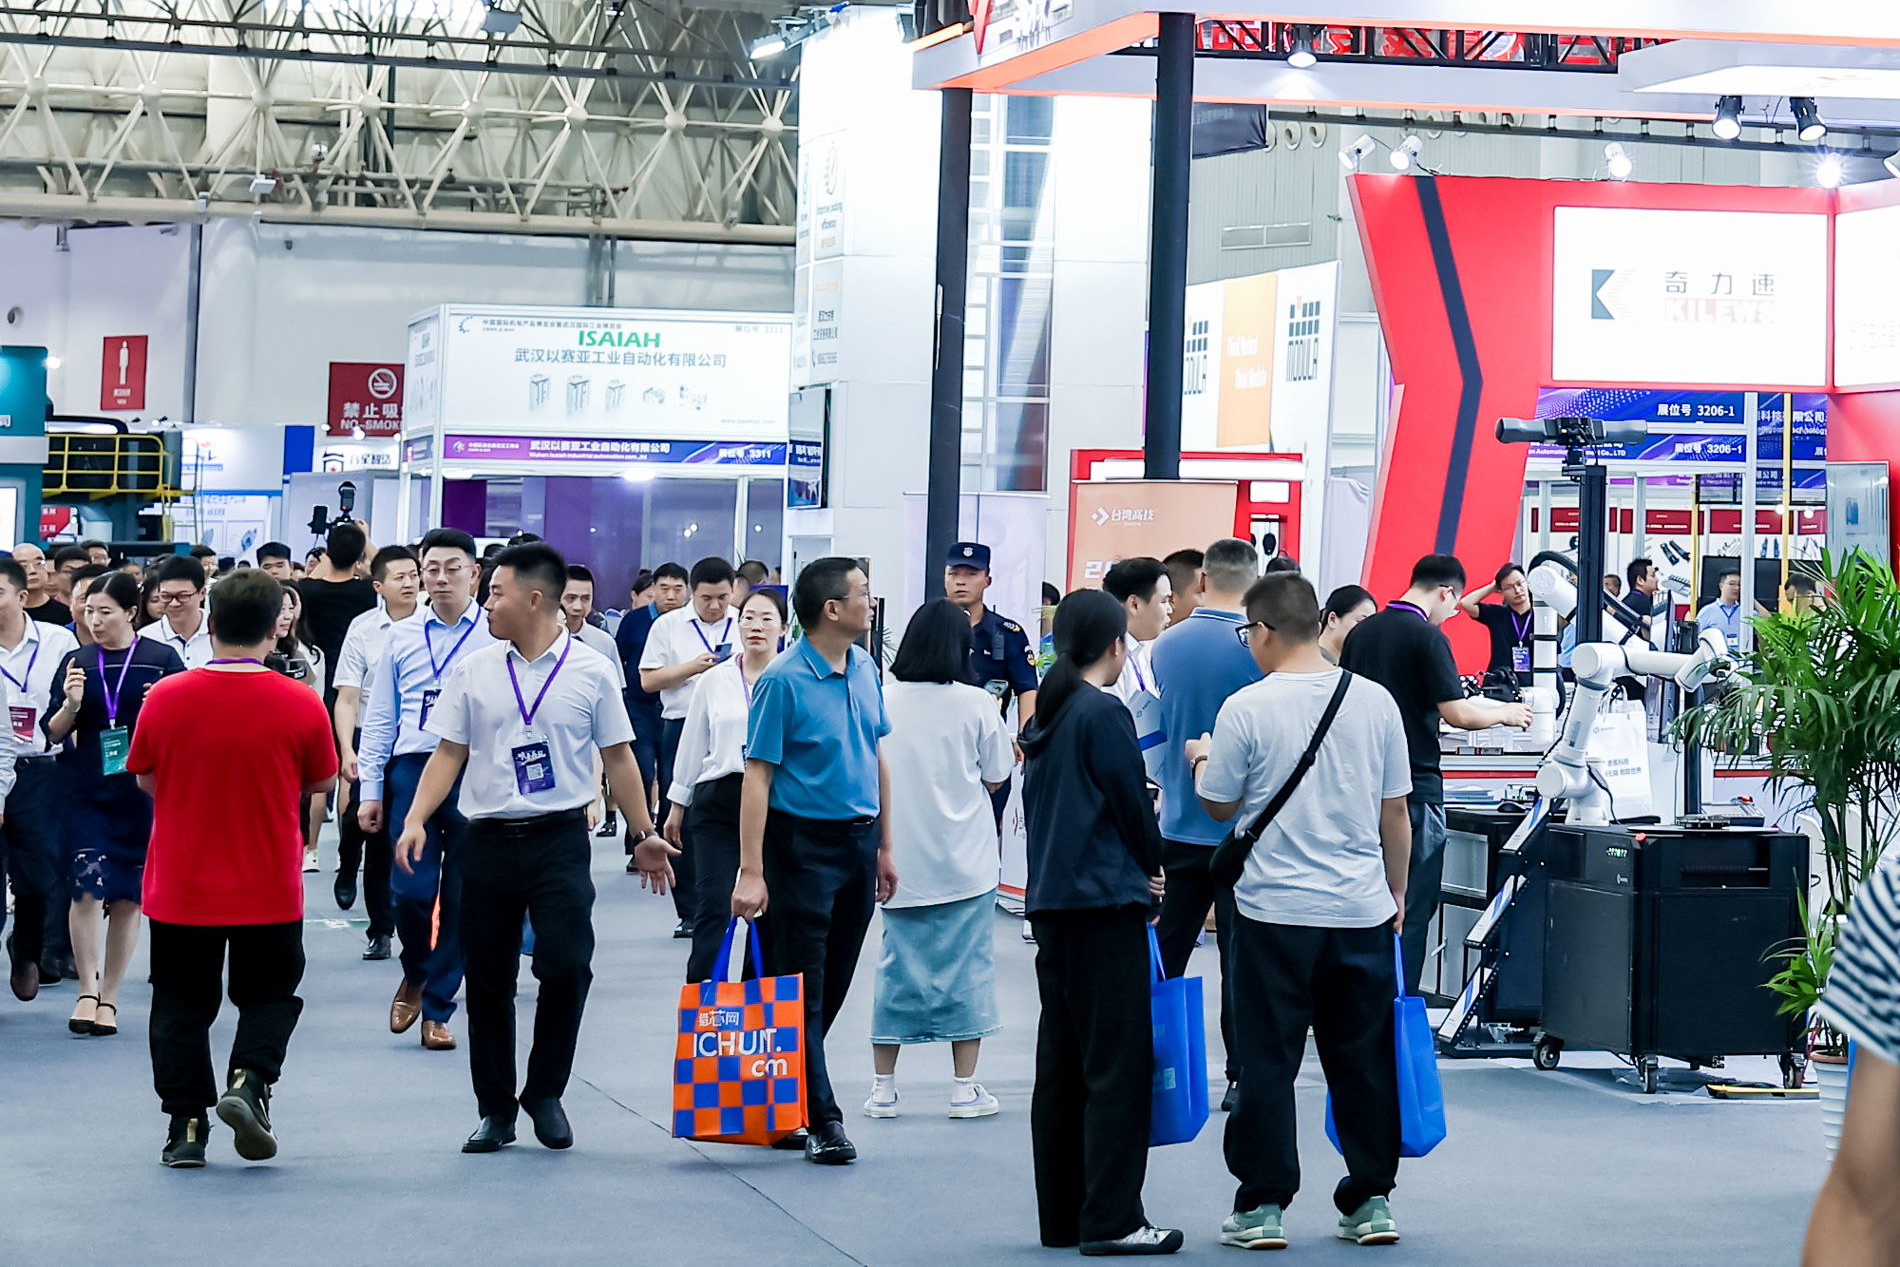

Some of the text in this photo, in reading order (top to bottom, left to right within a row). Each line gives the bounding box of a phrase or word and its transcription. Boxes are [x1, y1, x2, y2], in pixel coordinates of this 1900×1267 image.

[1665, 270, 1775, 295] 奇力速
[1665, 297, 1775, 324] KILEWS
[578, 330, 661, 348] ISAIAH
[515, 347, 727, 369] 武汉以赛亚工业自动化有限公司
[343, 402, 403, 419] 禁止吸
[1656, 403, 1735, 417] 展位号 3206-1
[749, 448, 772, 459] 3311
[1674, 443, 1742, 455] 展位号 3206-1
[699, 1009, 740, 1028] 猎芯网
